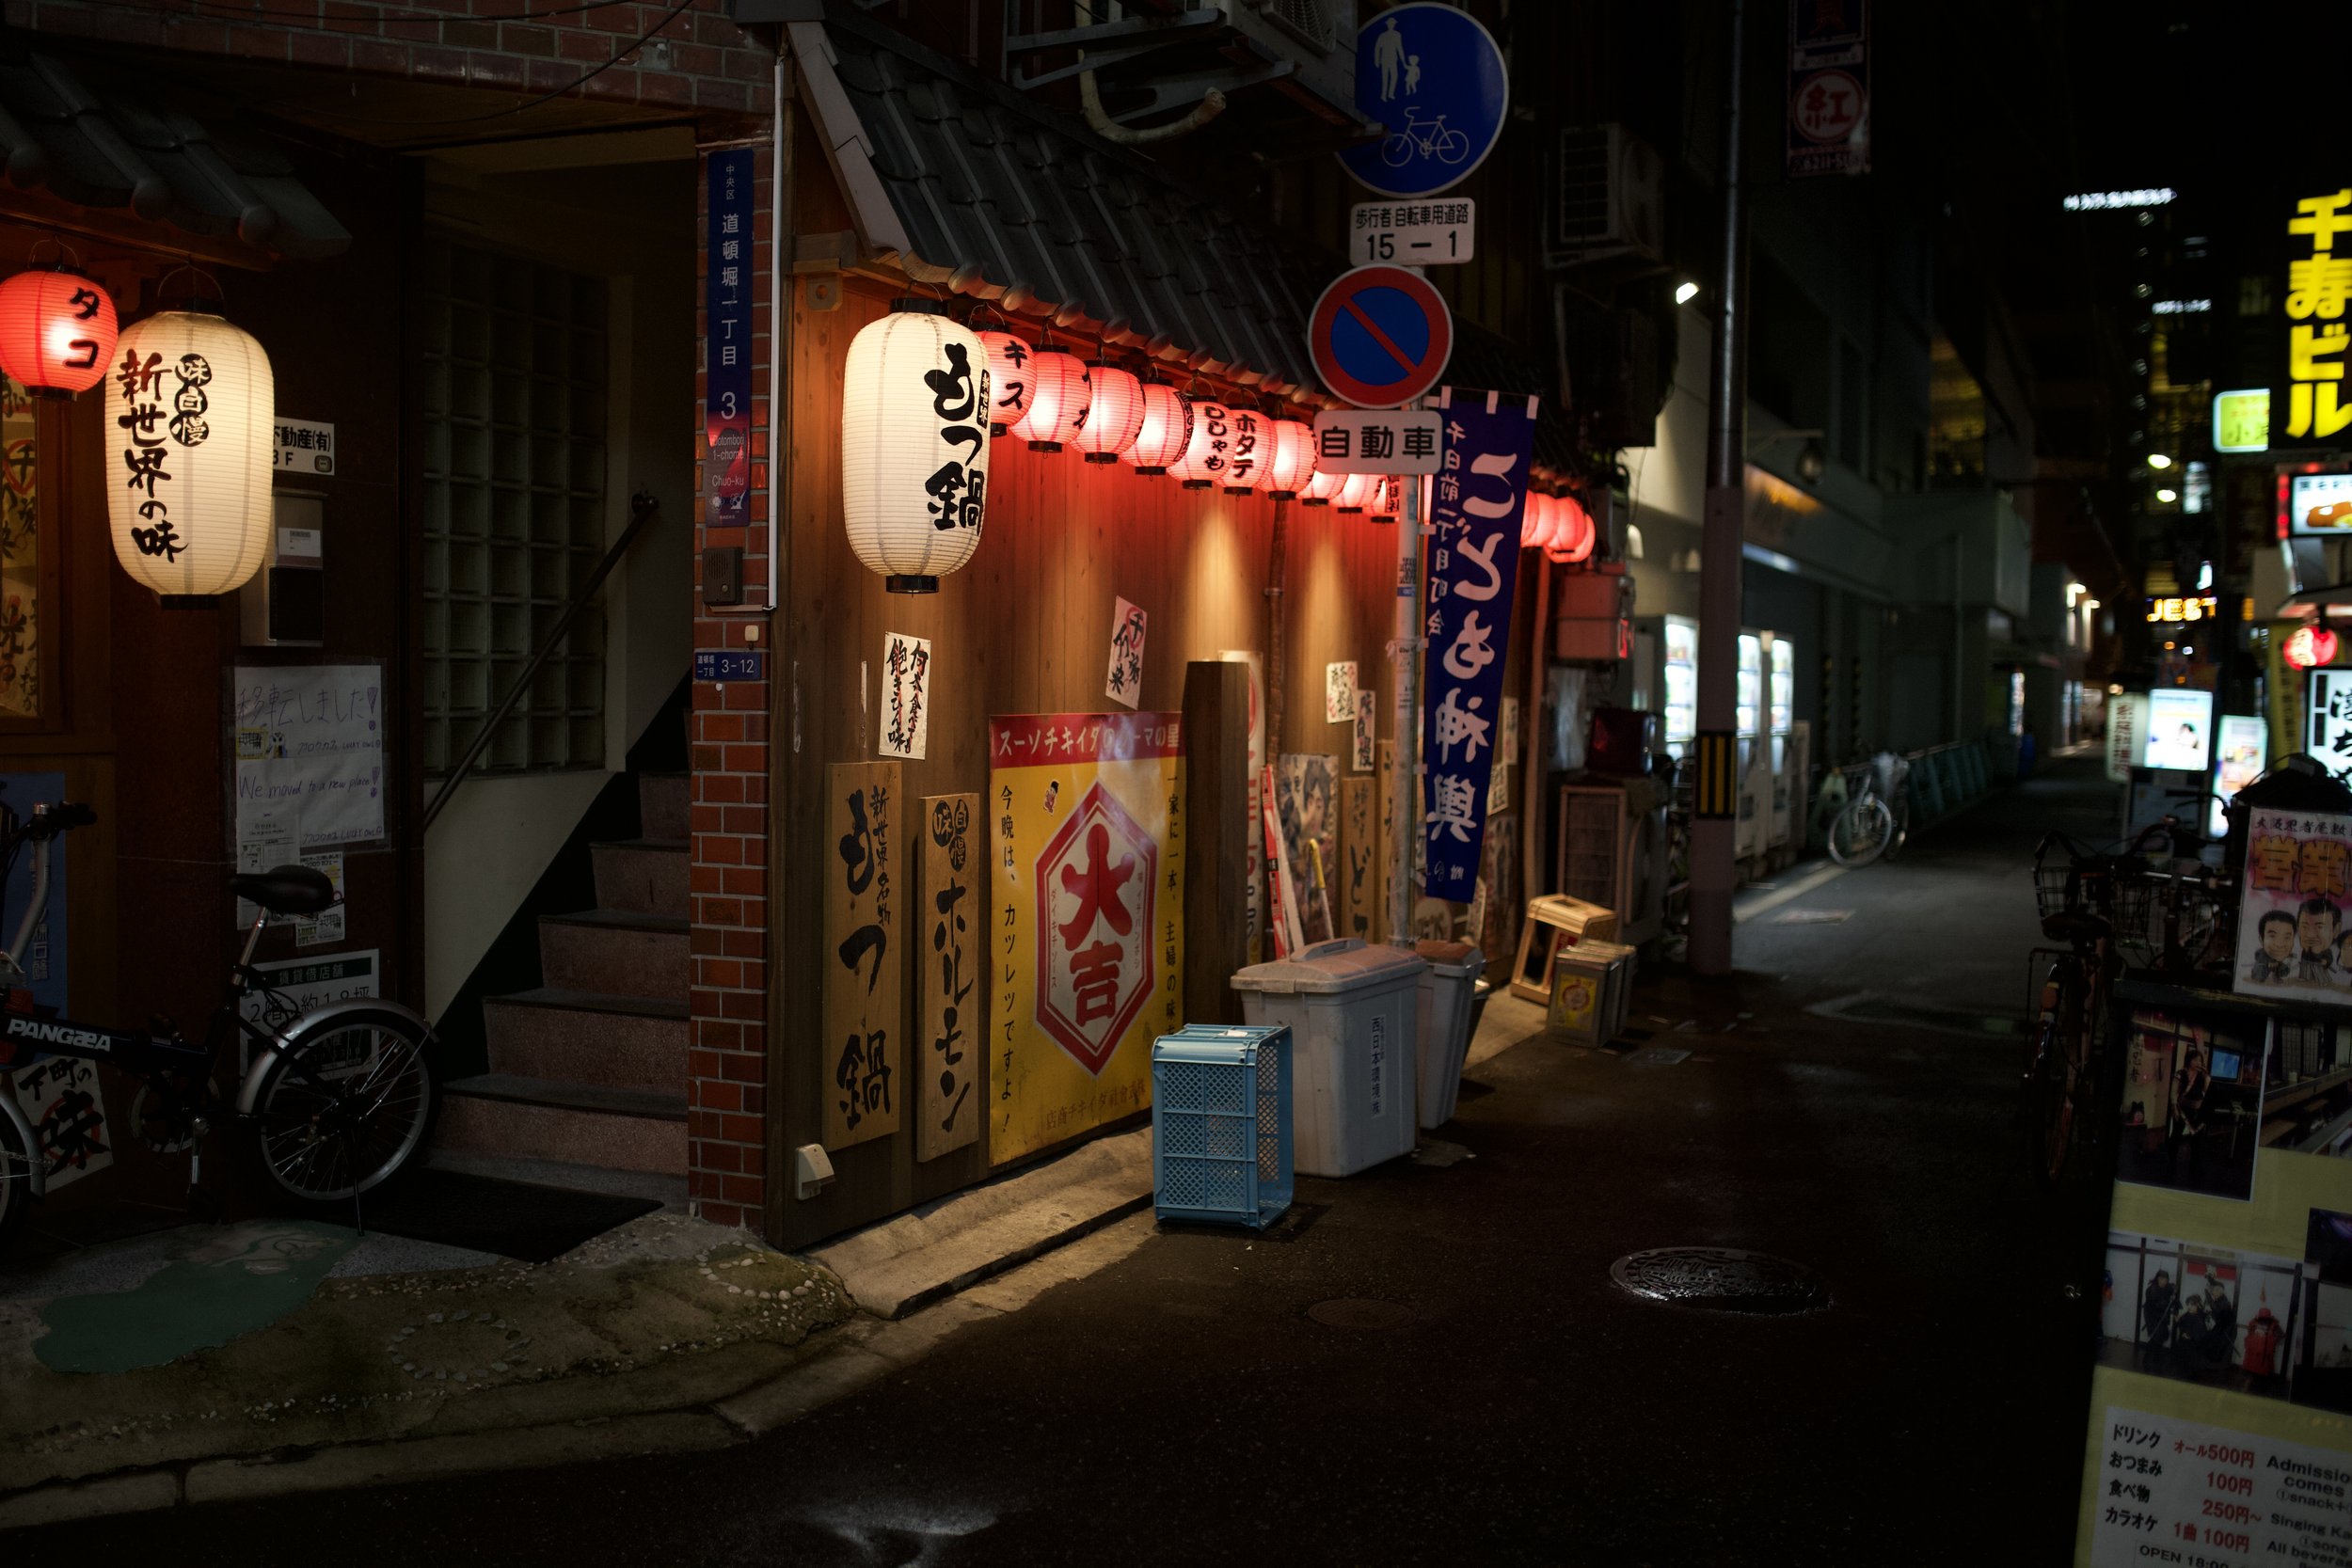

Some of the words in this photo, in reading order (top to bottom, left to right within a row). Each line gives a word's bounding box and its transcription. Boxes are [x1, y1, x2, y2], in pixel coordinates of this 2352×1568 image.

[1806, 83, 1851, 129] 紅
[725, 164, 735, 199] 中央区
[721, 214, 739, 366] 道頓堀一丁目
[65, 287, 101, 370] タコ
[998, 341, 1028, 411] キス
[169, 354, 213, 447] 味自慢
[721, 391, 737, 420] 3
[117, 349, 188, 563] 新世界の味
[713, 434, 744, 446] Dotombori
[713, 450, 744, 460] 1-chome
[924, 342, 986, 536] もつ鍋
[1204, 405, 1228, 470] ししゃも
[1232, 414, 1257, 478] ホタテ
[1320, 425, 1436, 459] 自動車
[712, 475, 744, 487] Chuo-ku
[721, 658, 755, 673] 3-12
[238, 775, 262, 799] We
[268, 782, 302, 799] moved
[328, 779, 347, 790] new
[2255, 816, 2352, 837] 大阪忍者屋敷
[869, 785, 892, 926] 新世界名物
[836, 790, 891, 1131] もつ鍋
[934, 879, 974, 1132] ホルモン
[19, 1058, 92, 1101] 下町の
[2114, 1424, 2160, 1449] ドリンク
[2174, 1440, 2254, 1468] オール500円
[2109, 1451, 2162, 1477] おつまみ
[2207, 1472, 2252, 1497] 100円
[2109, 1479, 2151, 1503] 食べ物
[2267, 1455, 2352, 1485] Admissio
[2284, 1477, 2344, 1497] comes
[2106, 1507, 2158, 1531] カラオケ
[2205, 1528, 2249, 1554] 100円
[2271, 1513, 2326, 1536] Singing
[2139, 1544, 2181, 1563] OPEN
[2267, 1540, 2286, 1554] All
